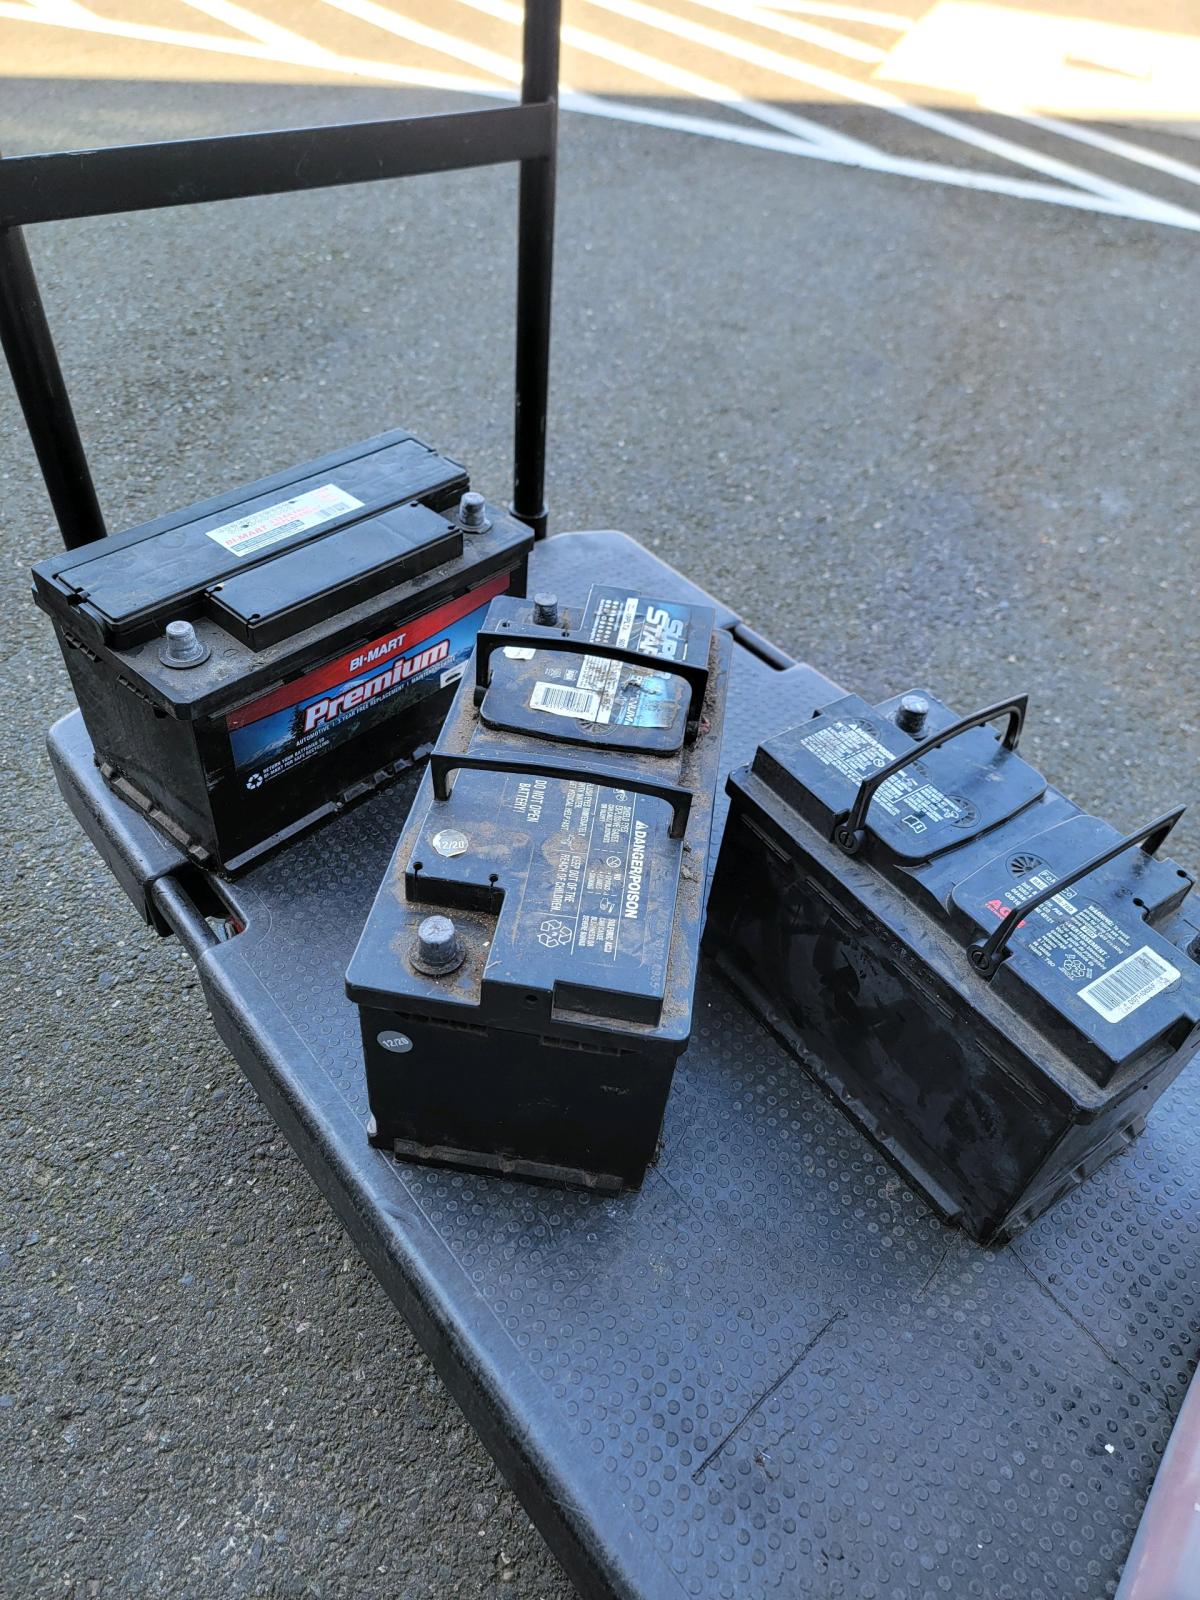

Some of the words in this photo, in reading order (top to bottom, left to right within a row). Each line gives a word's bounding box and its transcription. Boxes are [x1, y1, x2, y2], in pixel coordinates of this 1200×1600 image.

[304, 640, 449, 731] Premium
[296, 725, 330, 746] AUTOMOTIVE
[356, 704, 368, 715] FREE
[370, 684, 405, 708] REPLACEMENT
[534, 779, 546, 790] DO
[512, 782, 532, 813] BATTERY!
[530, 790, 544, 803] NOT
[526, 804, 541, 822] OPEN
[437, 837, 464, 852] 2/20
[558, 853, 570, 872] REACH
[625, 832, 647, 918] DANGER/POISON
[1039, 871, 1074, 897] FoCo
[564, 891, 575, 902] THE
[382, 1036, 409, 1048] 12/20
